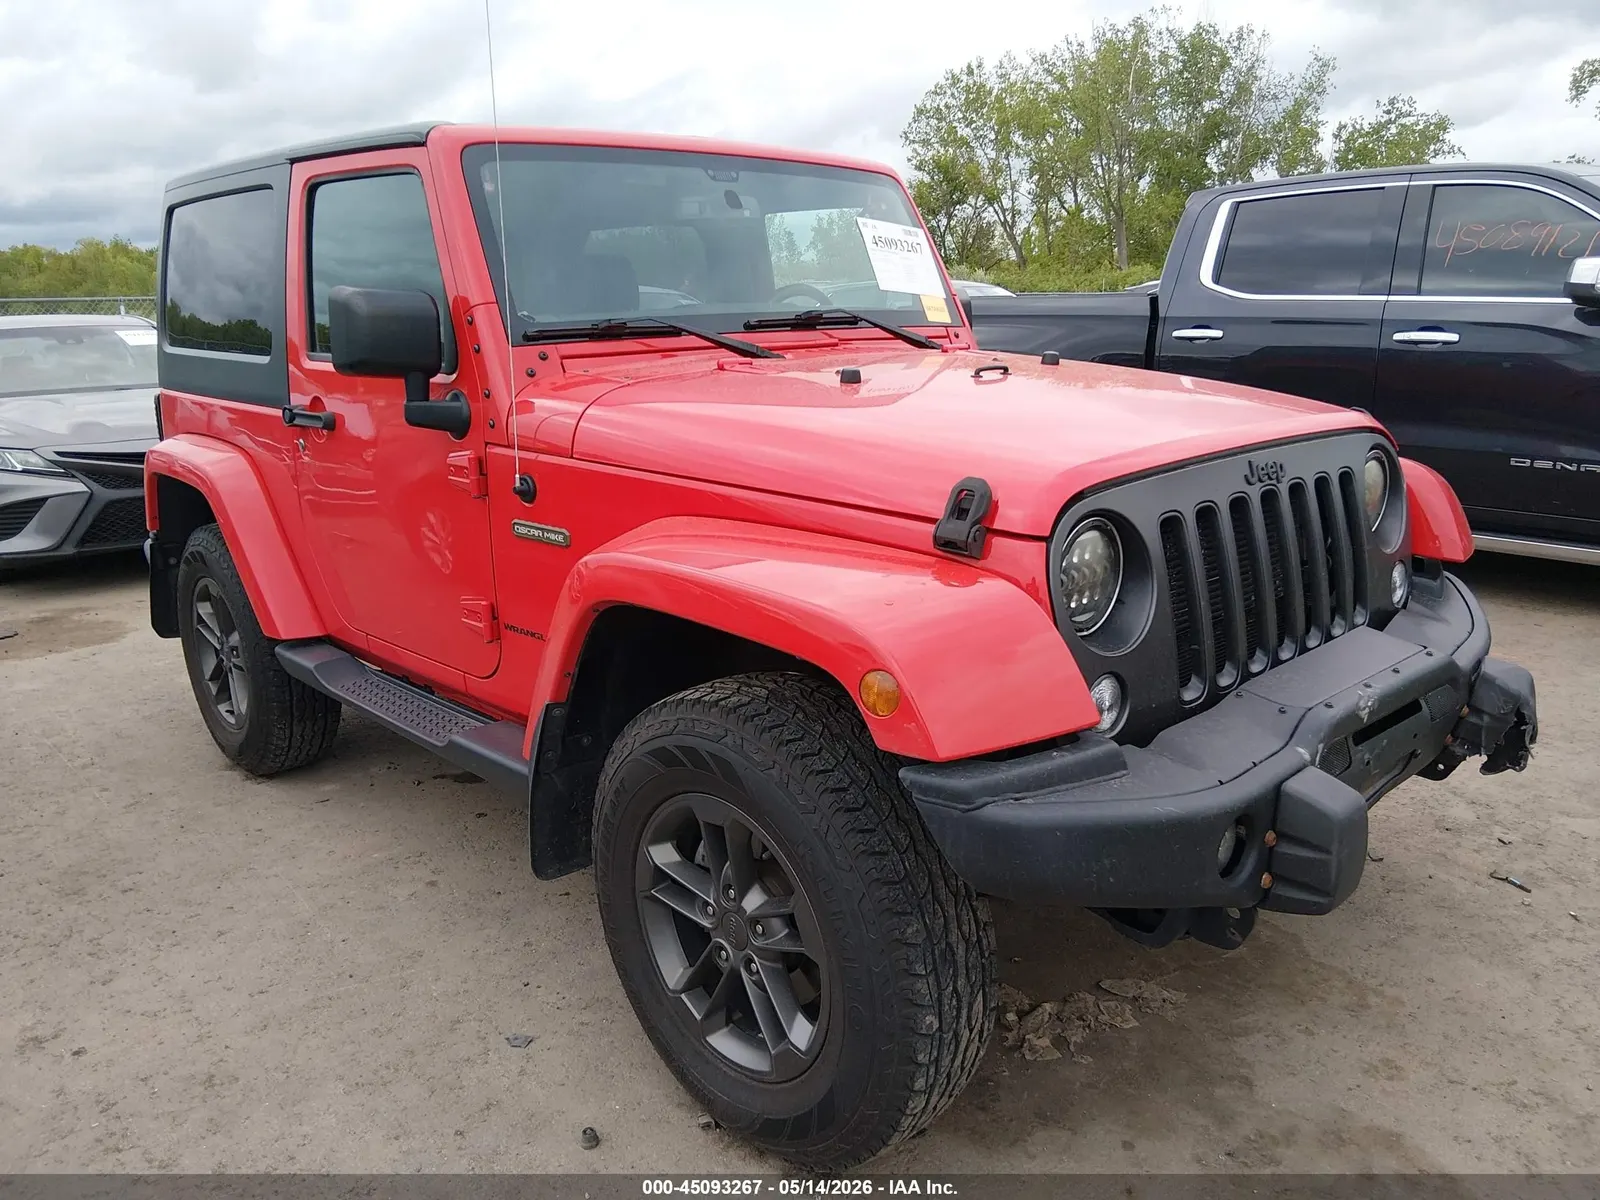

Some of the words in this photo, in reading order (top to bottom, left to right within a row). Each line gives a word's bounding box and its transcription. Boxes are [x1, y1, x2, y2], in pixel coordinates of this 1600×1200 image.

[871, 235, 923, 255] 45093267
[1244, 460, 1286, 486] Jeep
[514, 525, 543, 537] OSCAR
[544, 531, 564, 542] MIKE
